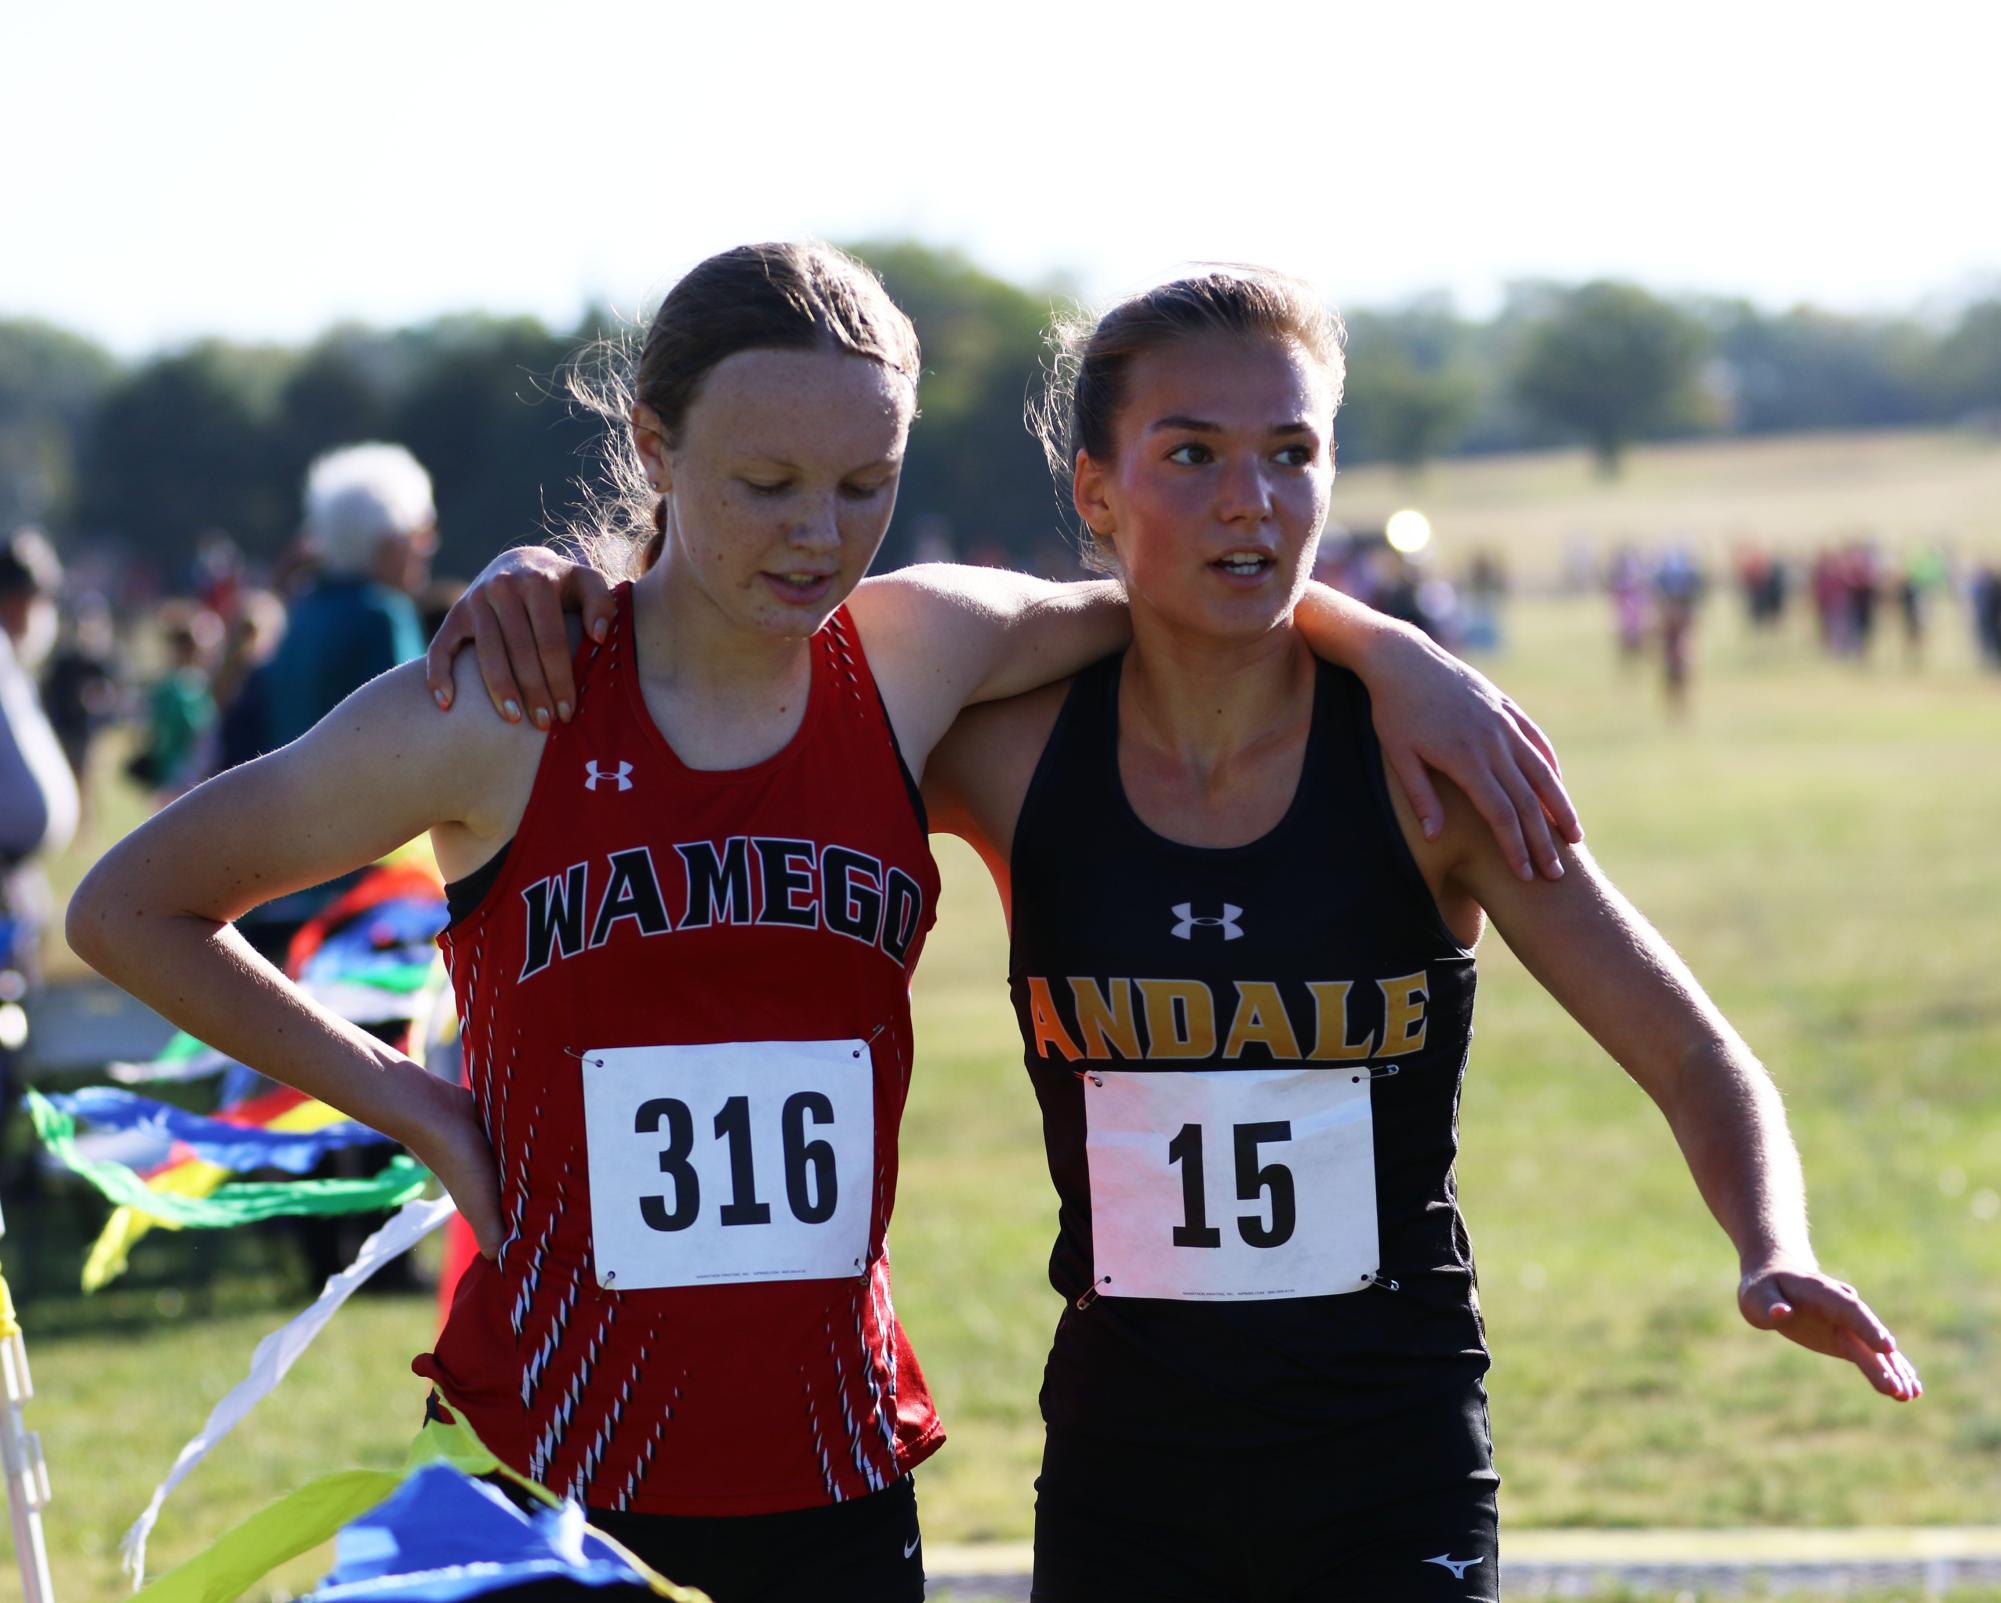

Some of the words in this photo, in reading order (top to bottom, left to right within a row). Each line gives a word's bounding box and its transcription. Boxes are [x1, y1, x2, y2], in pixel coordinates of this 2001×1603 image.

[517, 836, 922, 984] WAMEGO
[1027, 970, 1430, 1061] ANDALE
[634, 1090, 838, 1232] 316
[1168, 1120, 1297, 1249] 15
